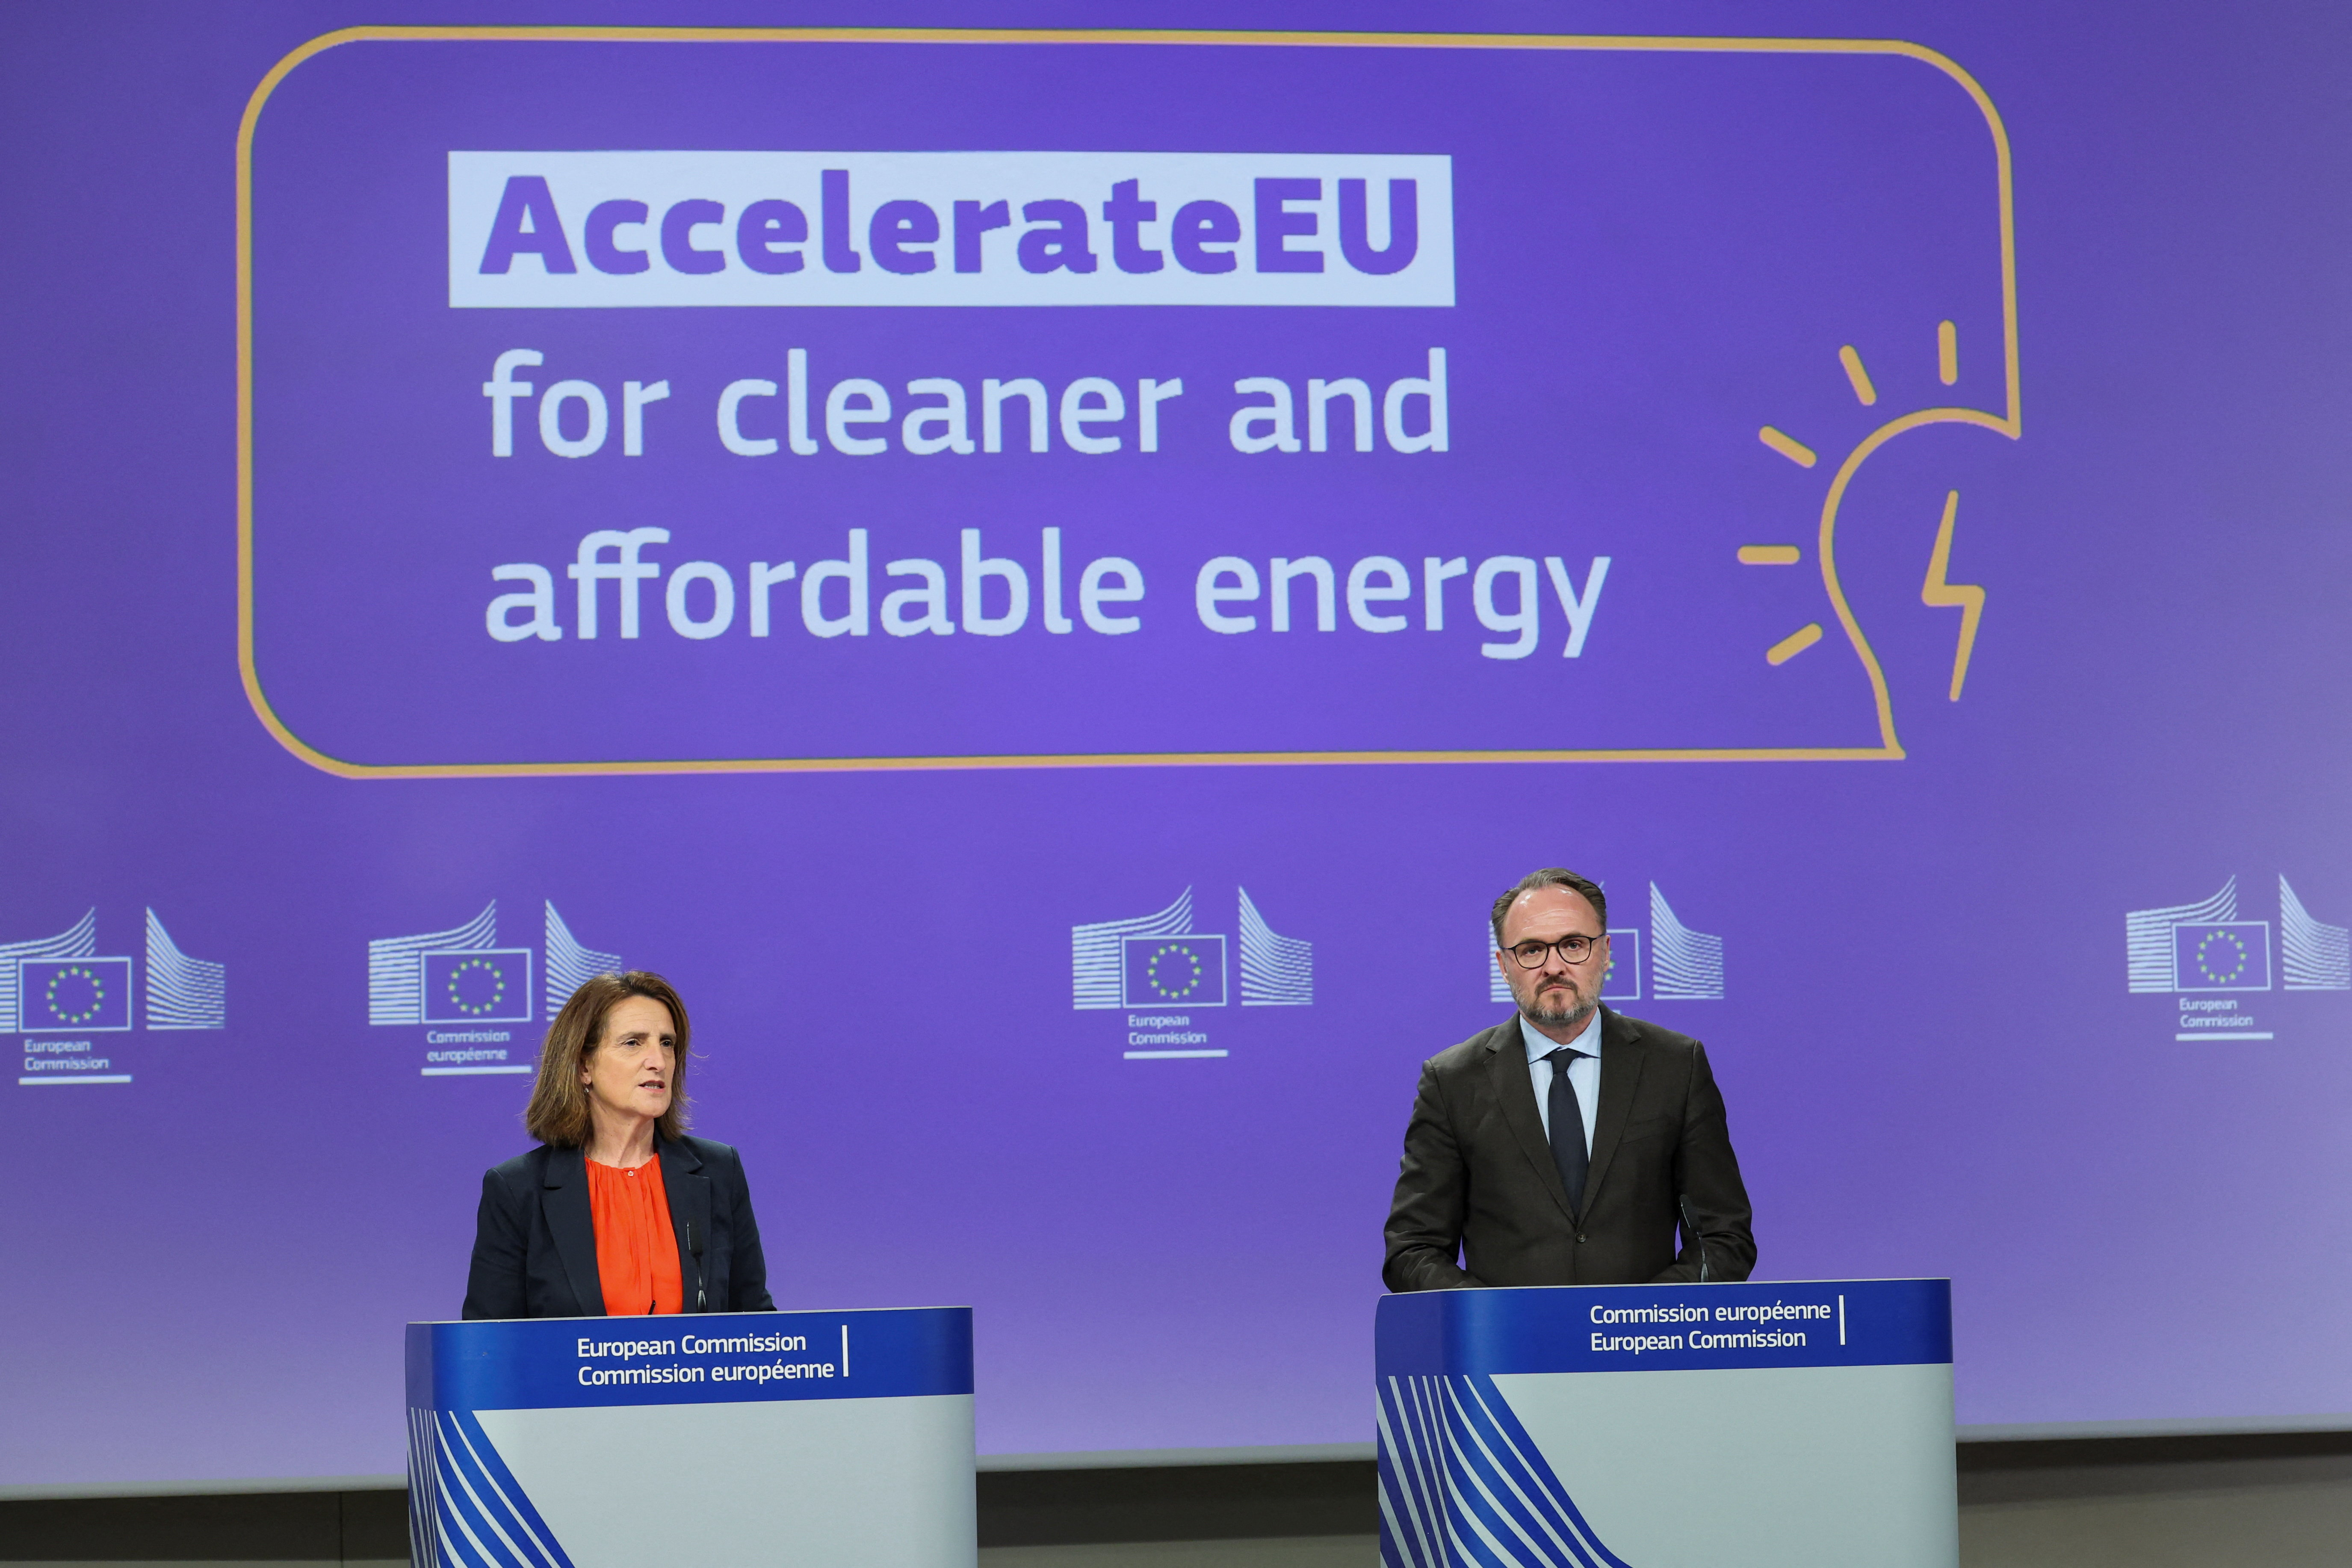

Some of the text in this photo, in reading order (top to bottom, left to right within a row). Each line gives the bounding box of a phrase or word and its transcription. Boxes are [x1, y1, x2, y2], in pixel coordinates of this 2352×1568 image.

[480, 170, 1418, 275] AccelerateEU
[483, 348, 1448, 458] for cleaner and
[487, 527, 1611, 659] affordable energy
[2179, 998, 2238, 1013] European
[1128, 1014, 1190, 1029] European
[2180, 1014, 2253, 1028] Commission
[427, 1030, 510, 1043] Commission
[1129, 1031, 1207, 1045] Commission
[24, 1039, 91, 1054] European
[24, 1057, 109, 1071] Commission
[427, 1047, 508, 1064] européenne
[1591, 1300, 1830, 1324] Commission européenne
[578, 1332, 806, 1360] European Commission
[1592, 1329, 1805, 1354] European Commission
[579, 1359, 834, 1385] Commission européenne
